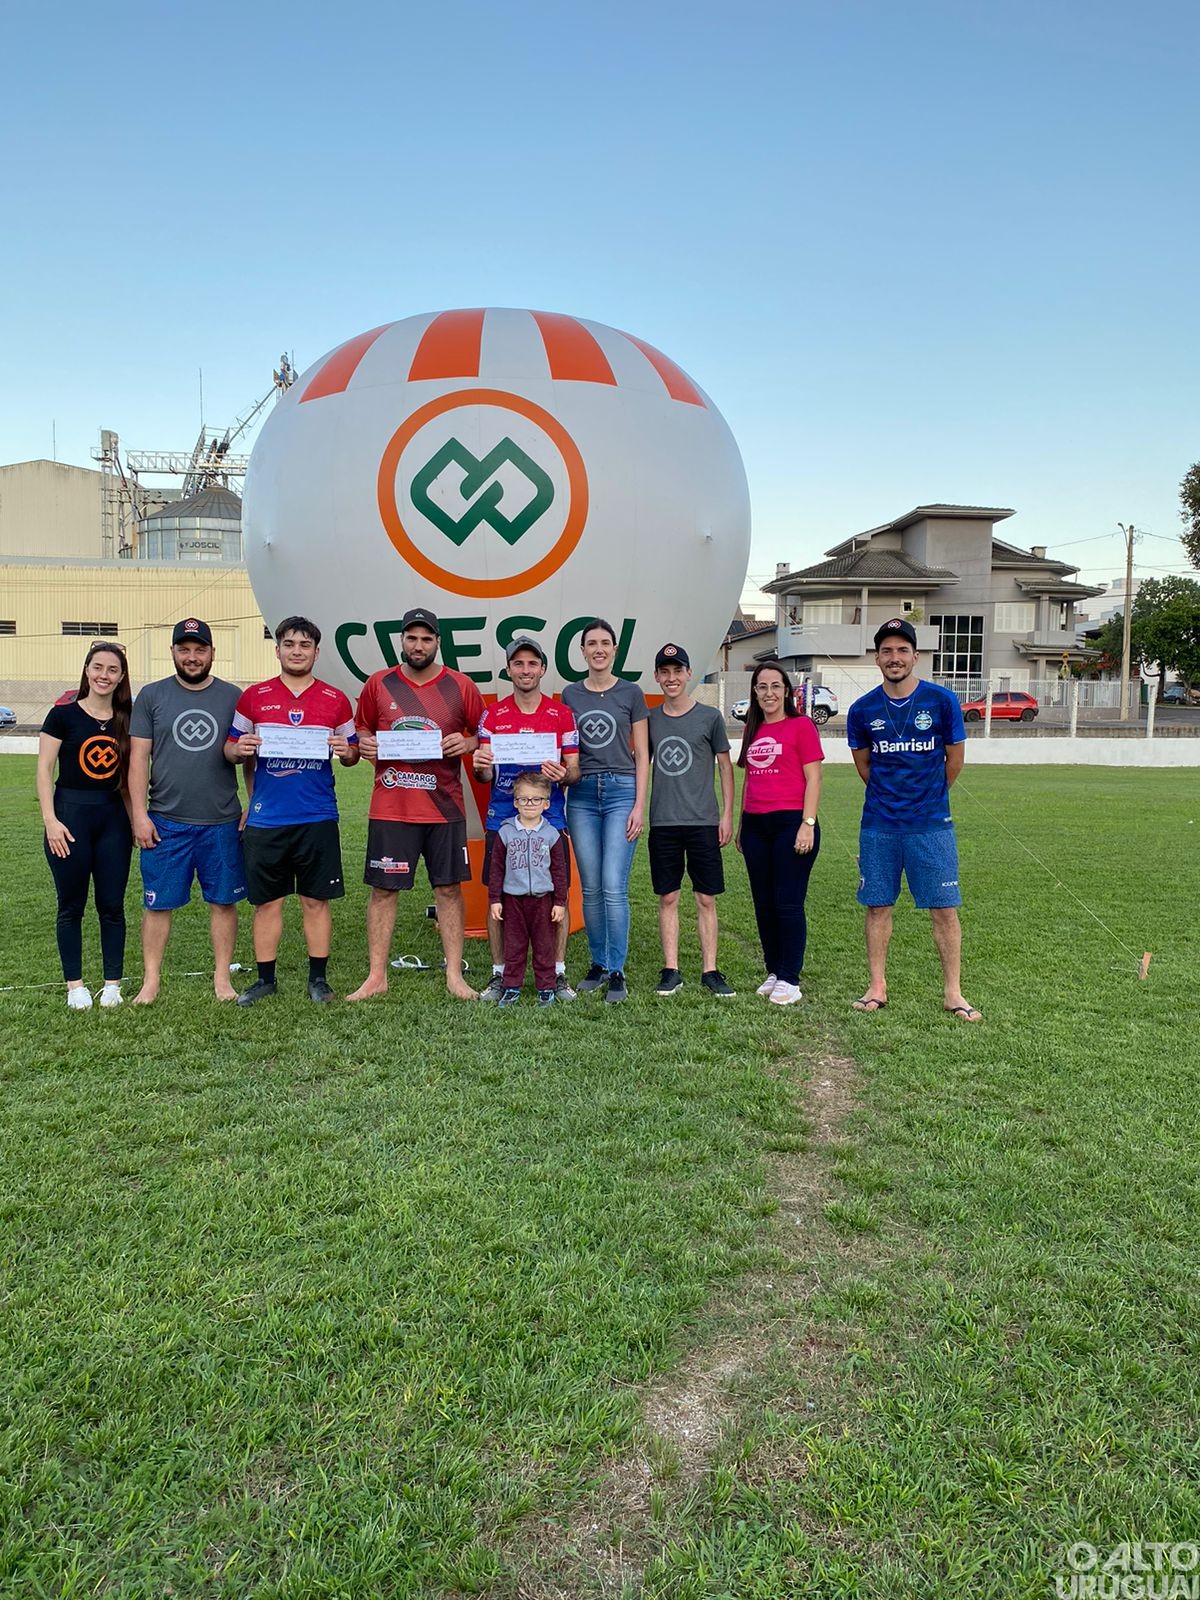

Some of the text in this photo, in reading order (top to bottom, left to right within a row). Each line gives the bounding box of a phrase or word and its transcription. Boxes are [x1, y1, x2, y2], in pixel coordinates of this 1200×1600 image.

[879, 736, 935, 754] Banrisul
[397, 772, 437, 784] CAMARGO
[462, 846, 469, 865] 1
[509, 837, 545, 856] SPORT
